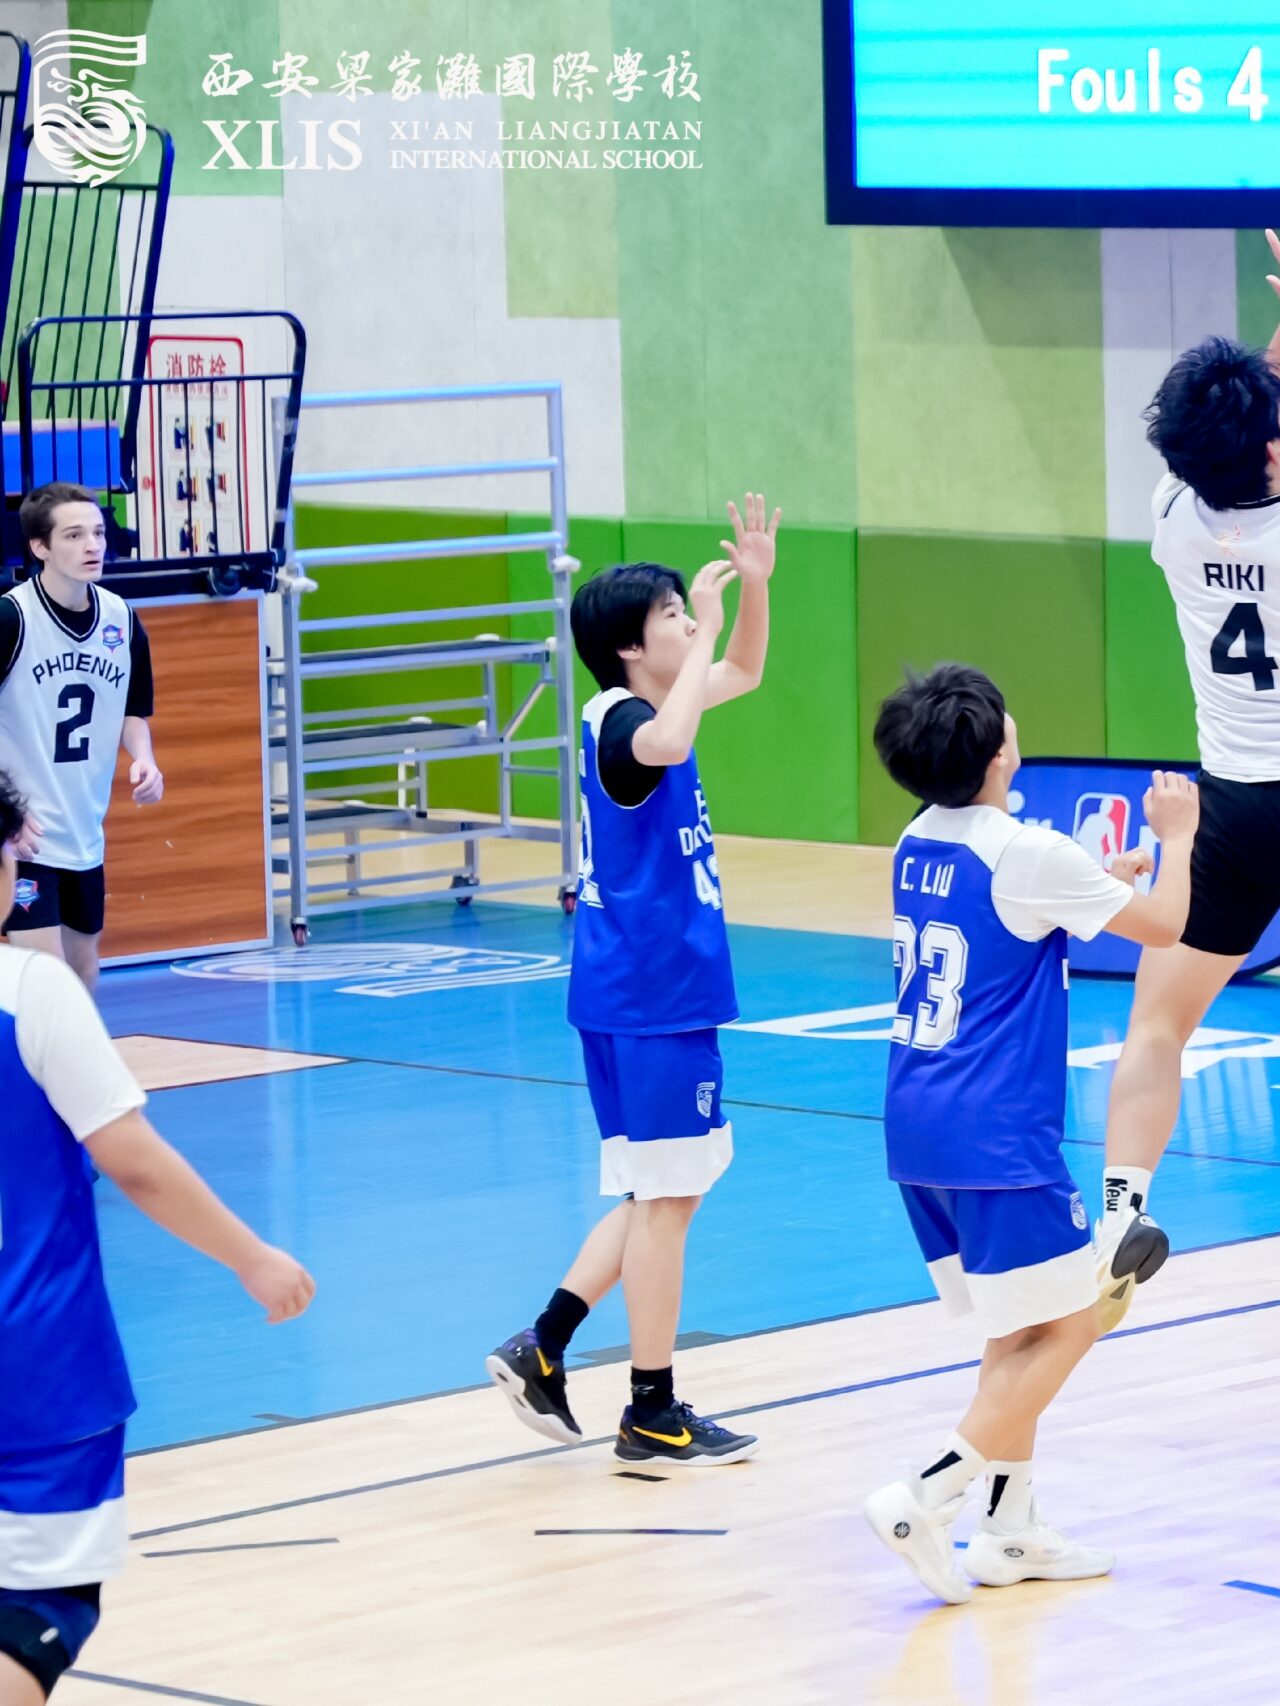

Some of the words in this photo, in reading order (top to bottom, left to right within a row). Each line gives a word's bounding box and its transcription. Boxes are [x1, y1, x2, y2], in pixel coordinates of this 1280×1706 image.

[1038, 48, 1204, 113] Fouls
[1227, 46, 1269, 122] 4
[1203, 562, 1265, 592] RIKI
[32, 652, 126, 689] PHOENIX
[1210, 602, 1280, 692] 4
[53, 682, 96, 764] 2
[920, 861, 955, 898] LIU
[889, 913, 970, 1052] 23
